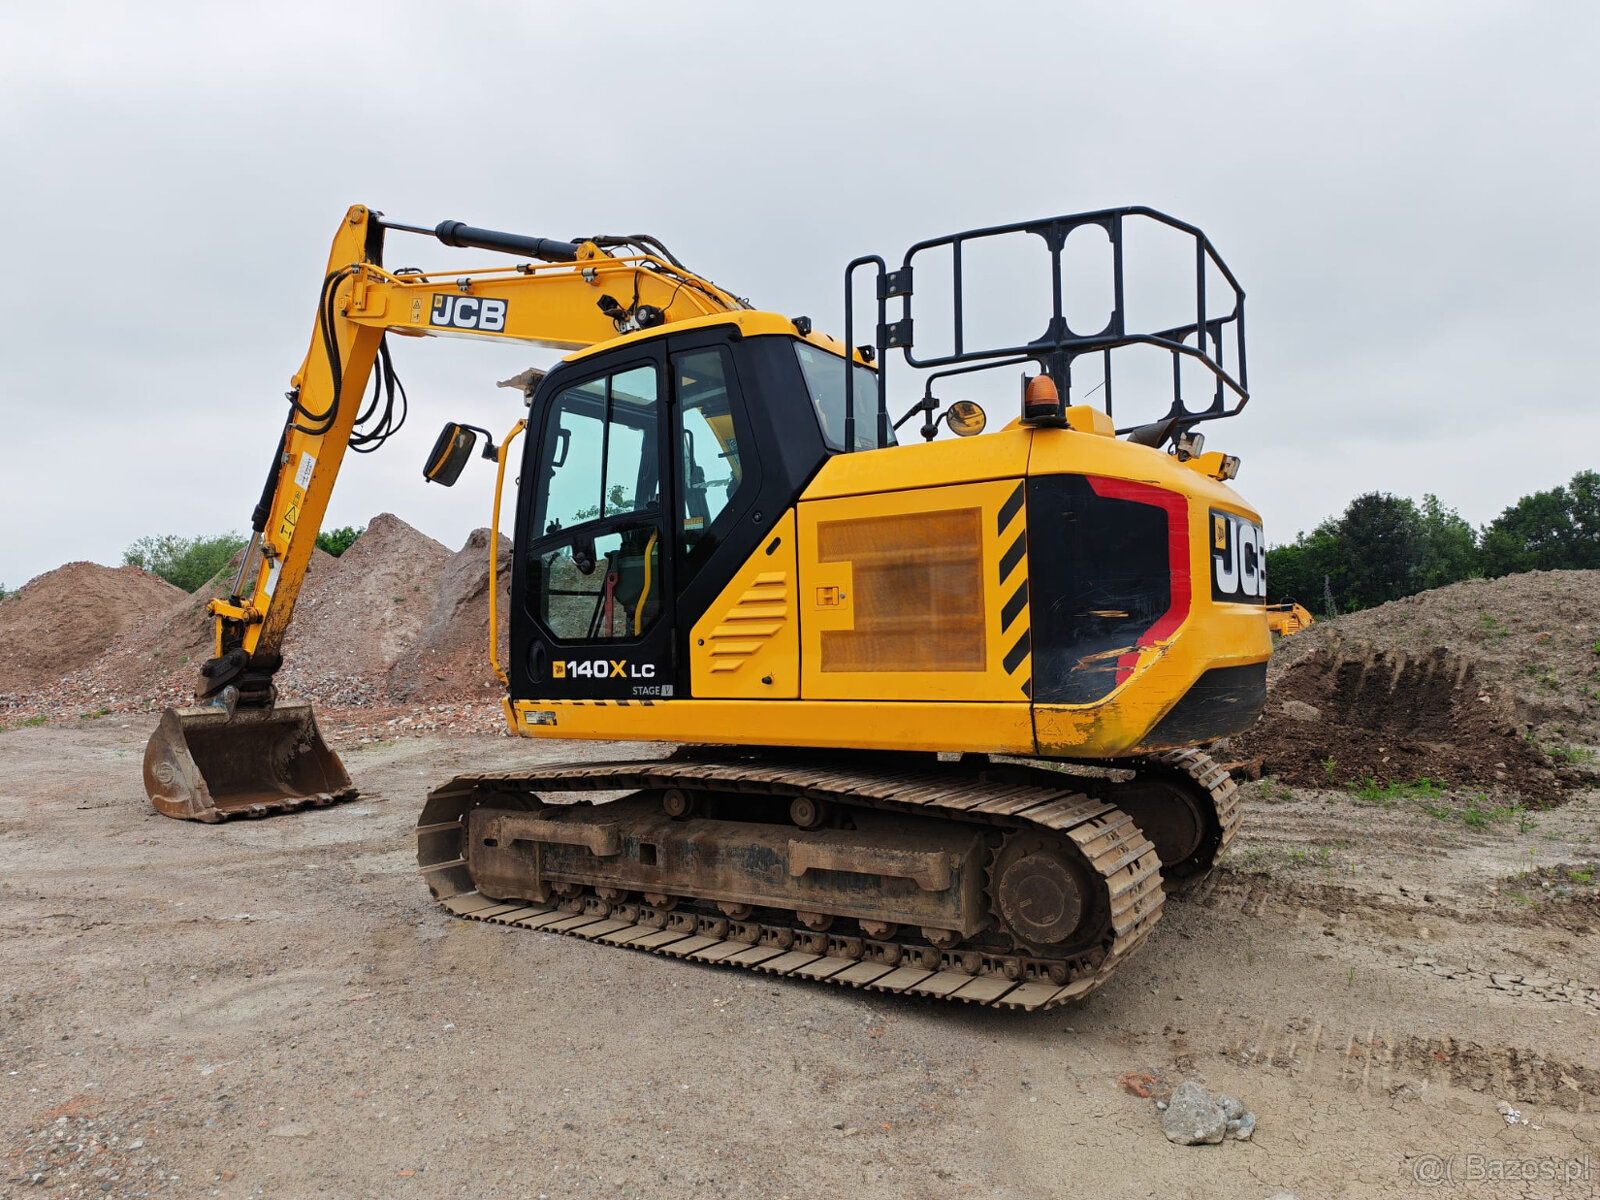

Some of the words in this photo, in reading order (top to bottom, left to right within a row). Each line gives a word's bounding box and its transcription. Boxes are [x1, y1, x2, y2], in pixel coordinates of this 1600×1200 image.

[431, 296, 505, 331] JCB
[566, 660, 627, 678] 140X
[631, 664, 656, 678] LC
[632, 686, 660, 696] STAGE
